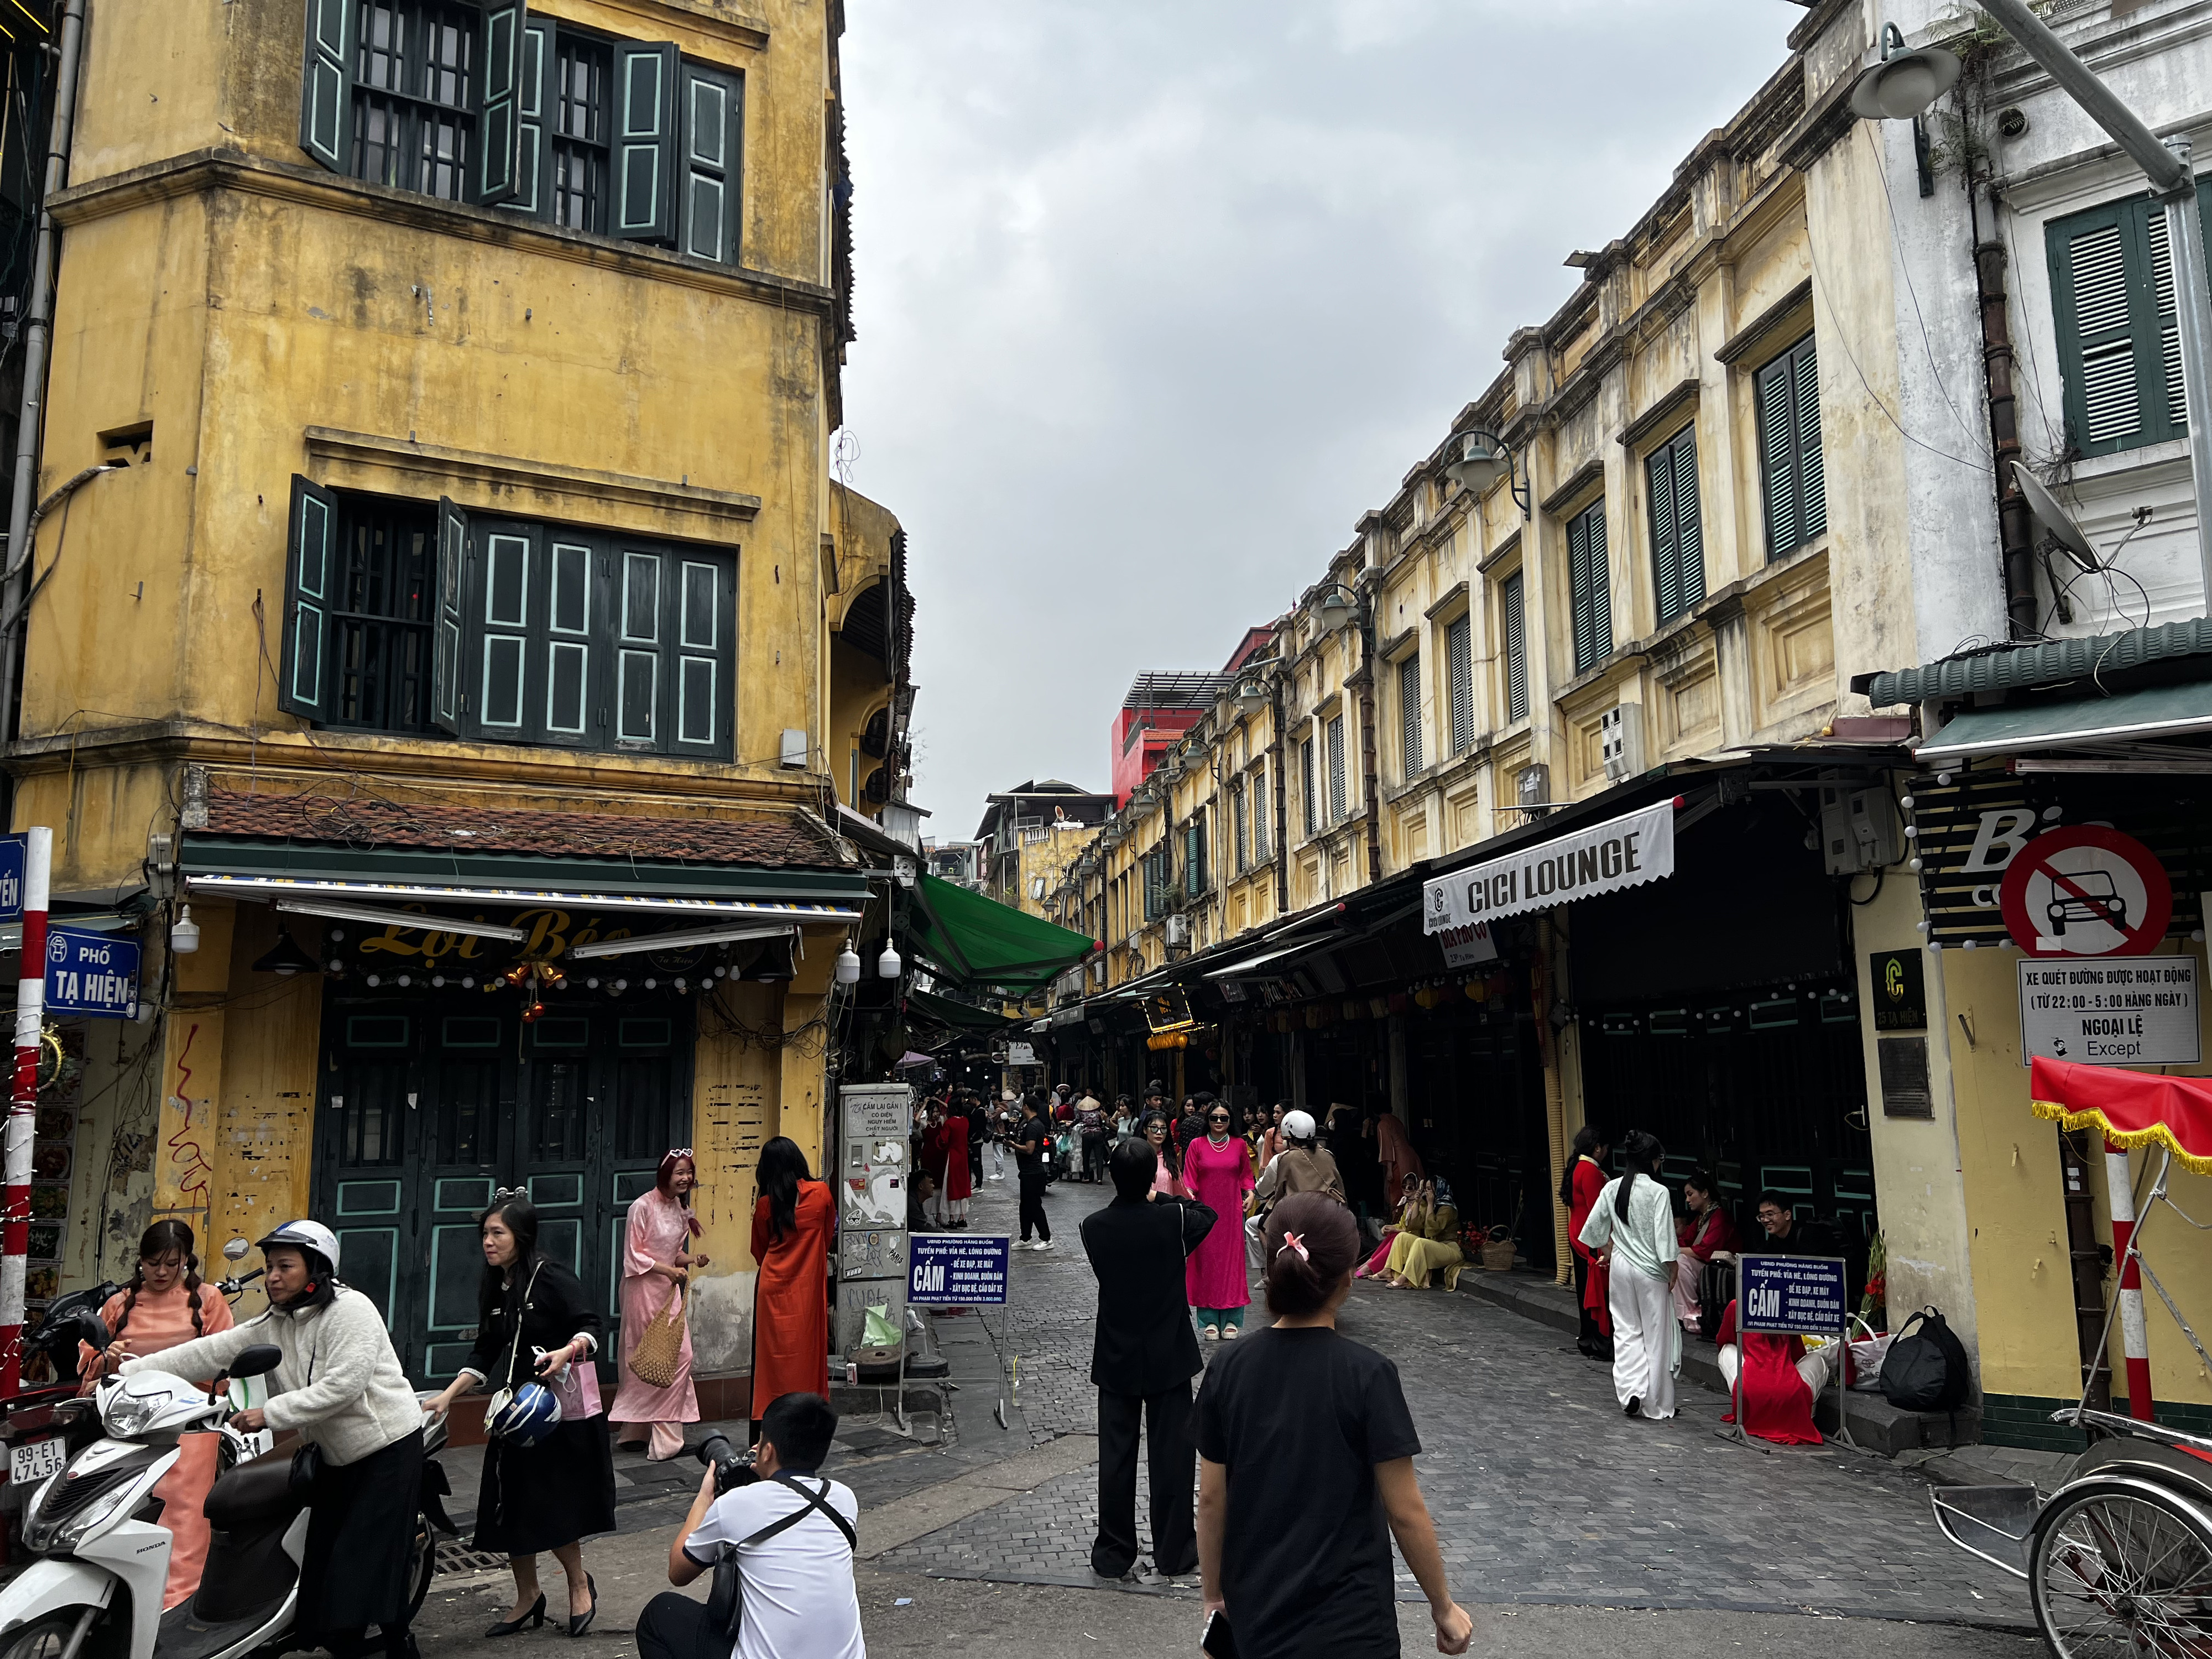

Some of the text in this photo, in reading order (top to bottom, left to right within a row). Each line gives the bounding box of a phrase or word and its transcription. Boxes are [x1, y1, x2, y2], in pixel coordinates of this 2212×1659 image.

[1468, 831, 1641, 914] CICI LOUNGE
[0, 869, 18, 907] ẾN
[79, 944, 112, 964] PHỐ
[2026, 966, 2191, 986] XE QUÉT ĐƯỜNG ĐƯỢC HOẠT ĐỘNG
[55, 969, 129, 1008] TẠ HIỆN
[2125, 990, 2151, 1008] HÀNG
[2081, 1014, 2143, 1038] NGOẠI LỆ
[2087, 1040, 2141, 1058] Except
[863, 1101, 875, 1110] CẤM
[888, 1249, 904, 1264] PARIS
[918, 1246, 934, 1254] TUYẾN
[914, 1256, 945, 1292] CẤM
[1751, 1268, 1768, 1277] TUYẾN
[1748, 1279, 1780, 1317] CẤM
[1796, 1285, 1801, 1294] XE
[1813, 1286, 1819, 1295] XE
[1833, 1314, 1840, 1323] XE
[18, 1441, 55, 1464] 99-E1
[14, 1457, 62, 1481] 474.56
[136, 1541, 166, 1554] HONDA
